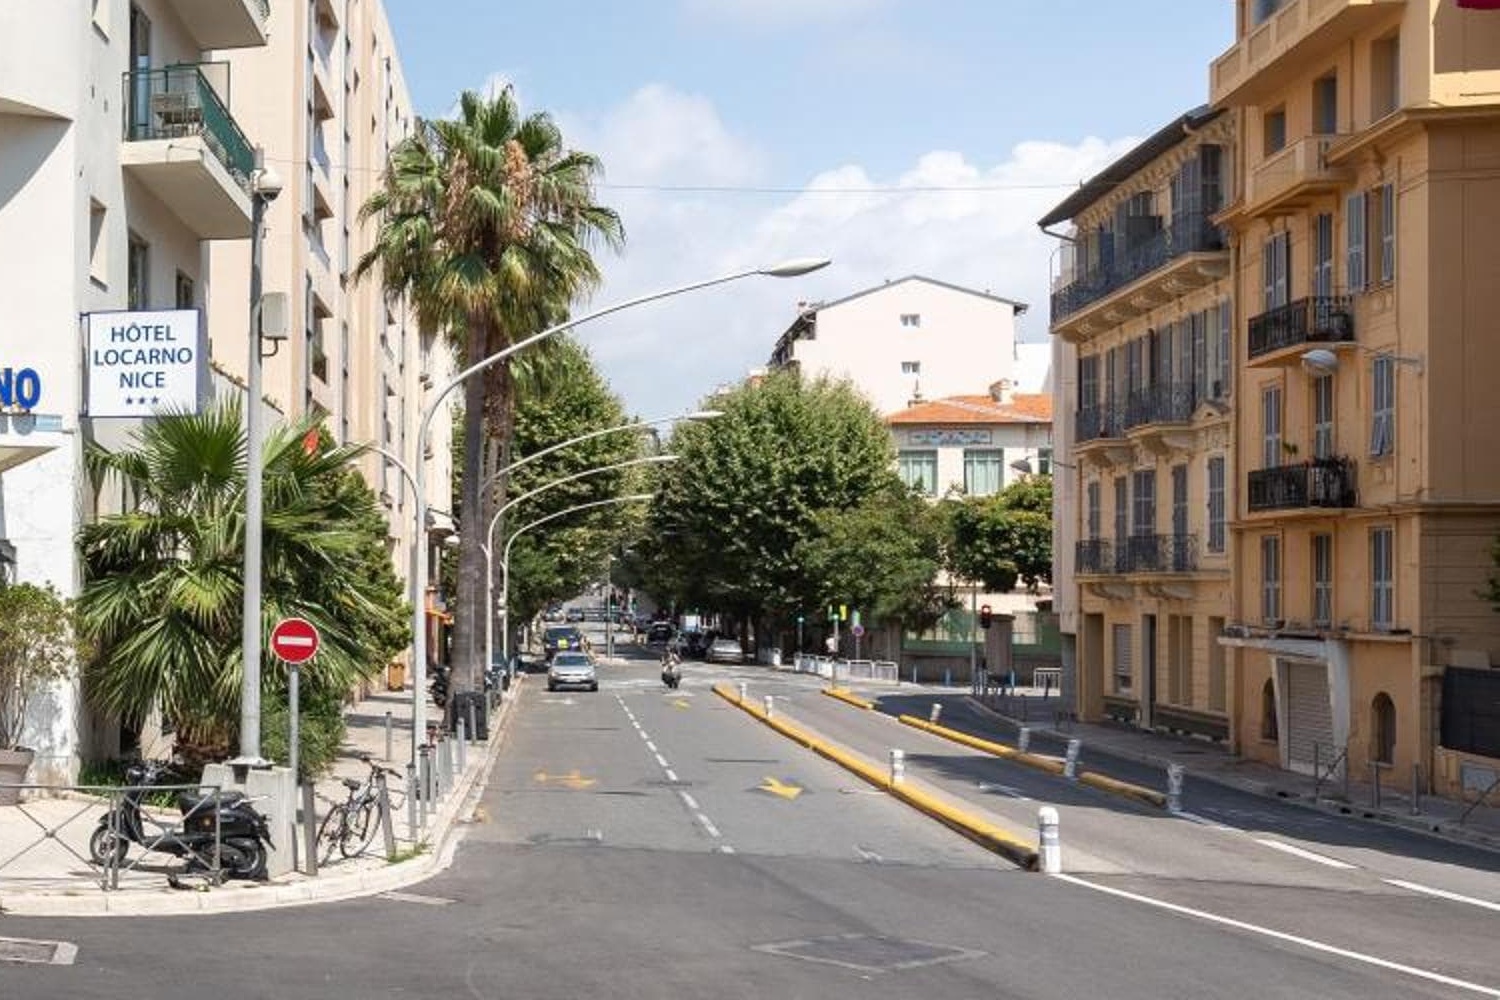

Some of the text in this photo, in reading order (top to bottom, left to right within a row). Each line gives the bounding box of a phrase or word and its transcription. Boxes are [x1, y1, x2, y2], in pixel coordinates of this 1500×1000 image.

[111, 324, 176, 343] HÔTEL
[94, 347, 193, 366] LOCARNO
[119, 371, 166, 389] NICE
